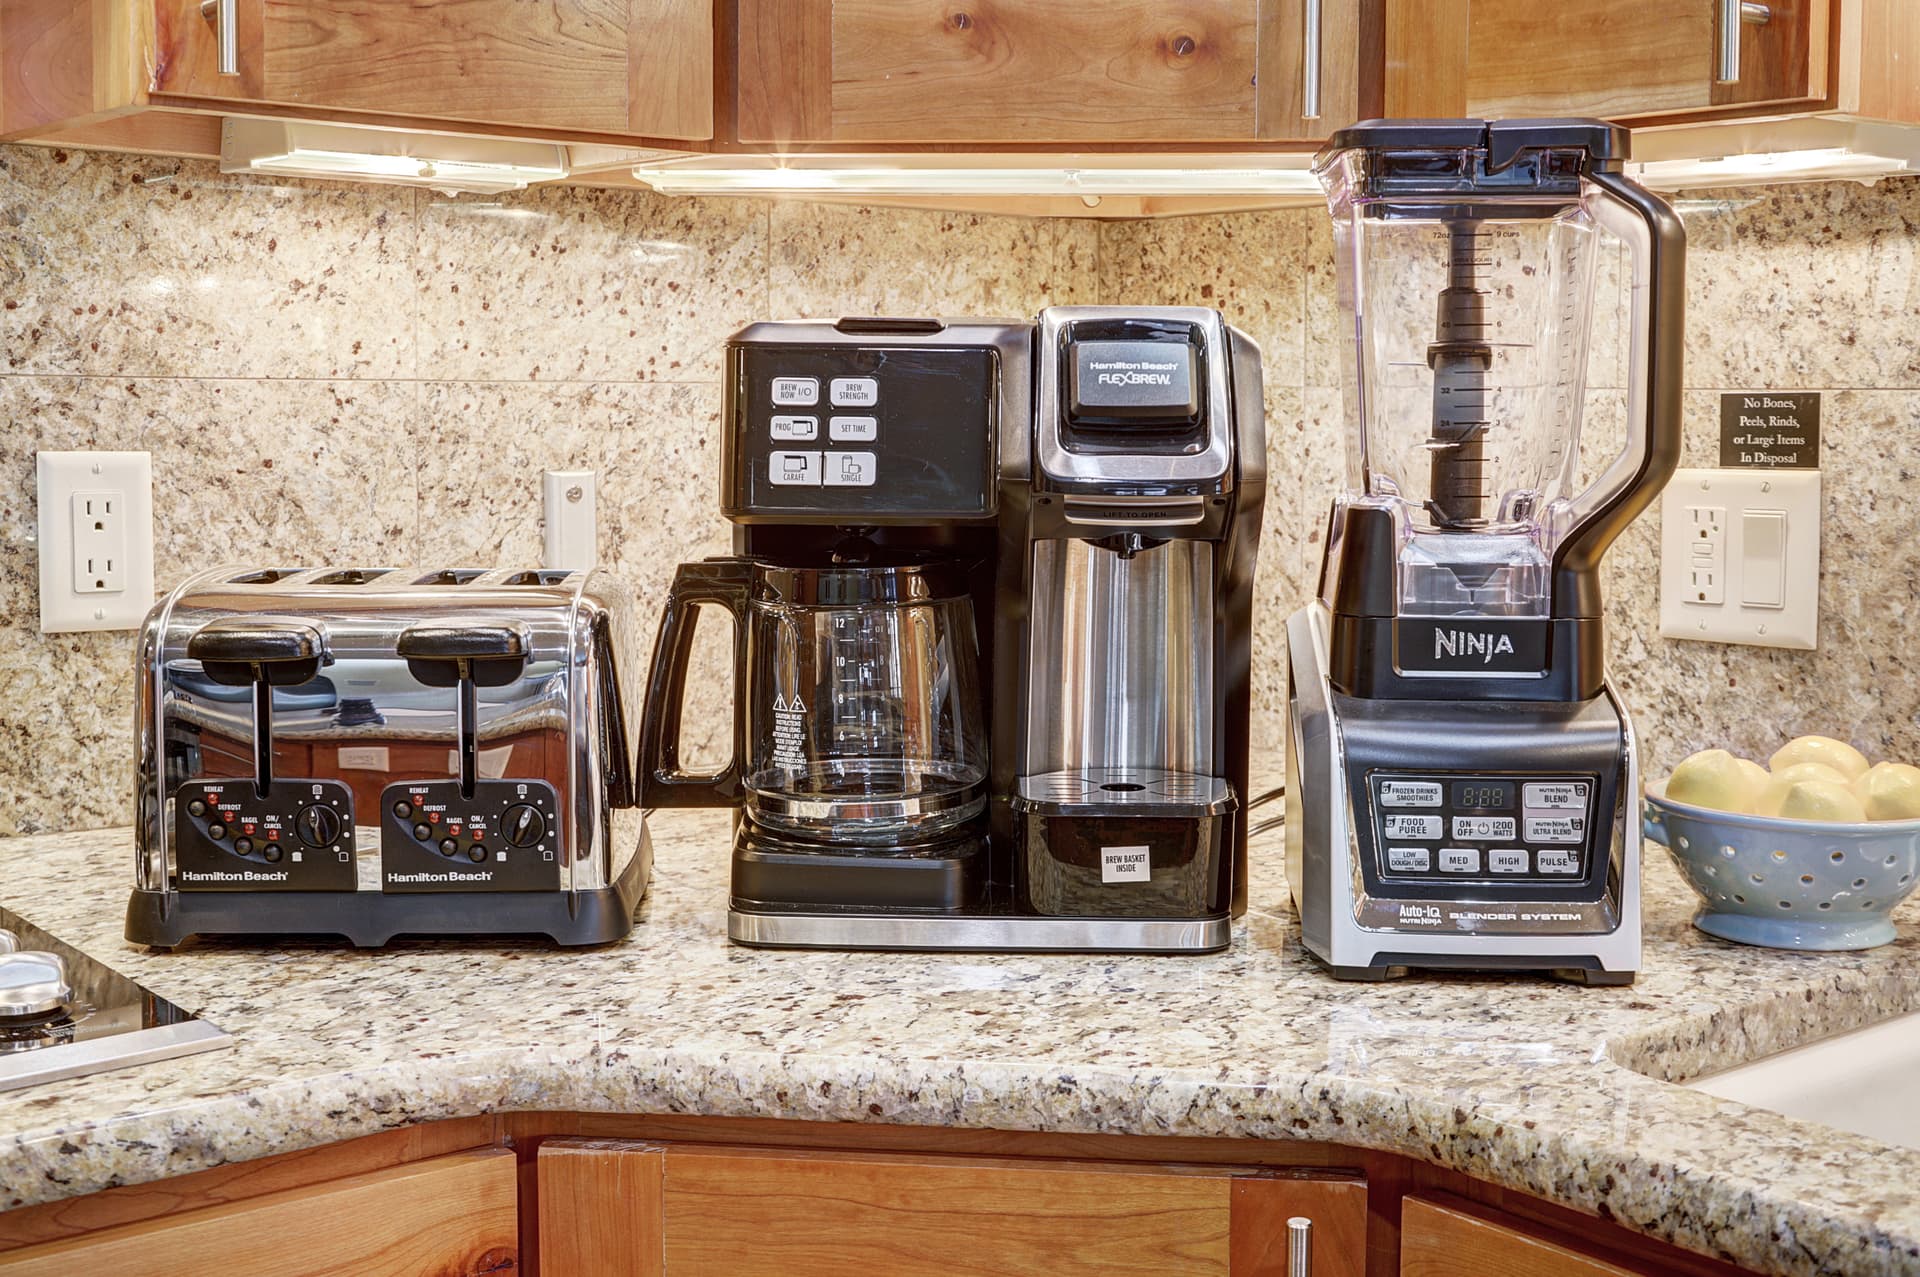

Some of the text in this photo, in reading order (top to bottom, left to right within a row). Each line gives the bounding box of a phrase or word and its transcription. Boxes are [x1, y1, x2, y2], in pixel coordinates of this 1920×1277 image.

[1090, 361, 1178, 371] Hamilton Beach
[1098, 371, 1171, 386] FLEXBREW
[846, 383, 863, 391] BREW
[780, 391, 795, 399] NOW
[839, 391, 869, 400] STRENGTH
[1743, 397, 1796, 409] No Bones,
[1739, 415, 1800, 428] Peels, Rinds,
[775, 423, 791, 432] PROG
[841, 424, 867, 433] SET TIME
[1733, 434, 1805, 448] or Large Items
[1740, 452, 1797, 466] In Disposal
[783, 473, 806, 481] CARAFE
[840, 474, 862, 482] SINGLE
[835, 618, 845, 628] 12
[1434, 627, 1514, 664] NINJA
[836, 656, 845, 667] 10
[838, 694, 844, 704] 8
[839, 731, 845, 741] 6
[1396, 794, 1434, 802] SMOOTHIES
[1544, 794, 1568, 803] BLEND
[1401, 818, 1425, 826] FOOD
[1459, 820, 1472, 828] ON
[1492, 821, 1513, 829] 1200
[1457, 828, 1474, 836] OFF
[1105, 854, 1146, 864] BREW BASKET
[1449, 856, 1468, 865] MED
[1498, 857, 1520, 865] HIGH
[1540, 857, 1568, 866] PULSE
[1116, 864, 1137, 872] INSIDE
[182, 871, 288, 881] Hamilton Beach
[387, 871, 493, 883] Hamilton Beach
[1449, 912, 1582, 921] BLENDER SYSTEM
